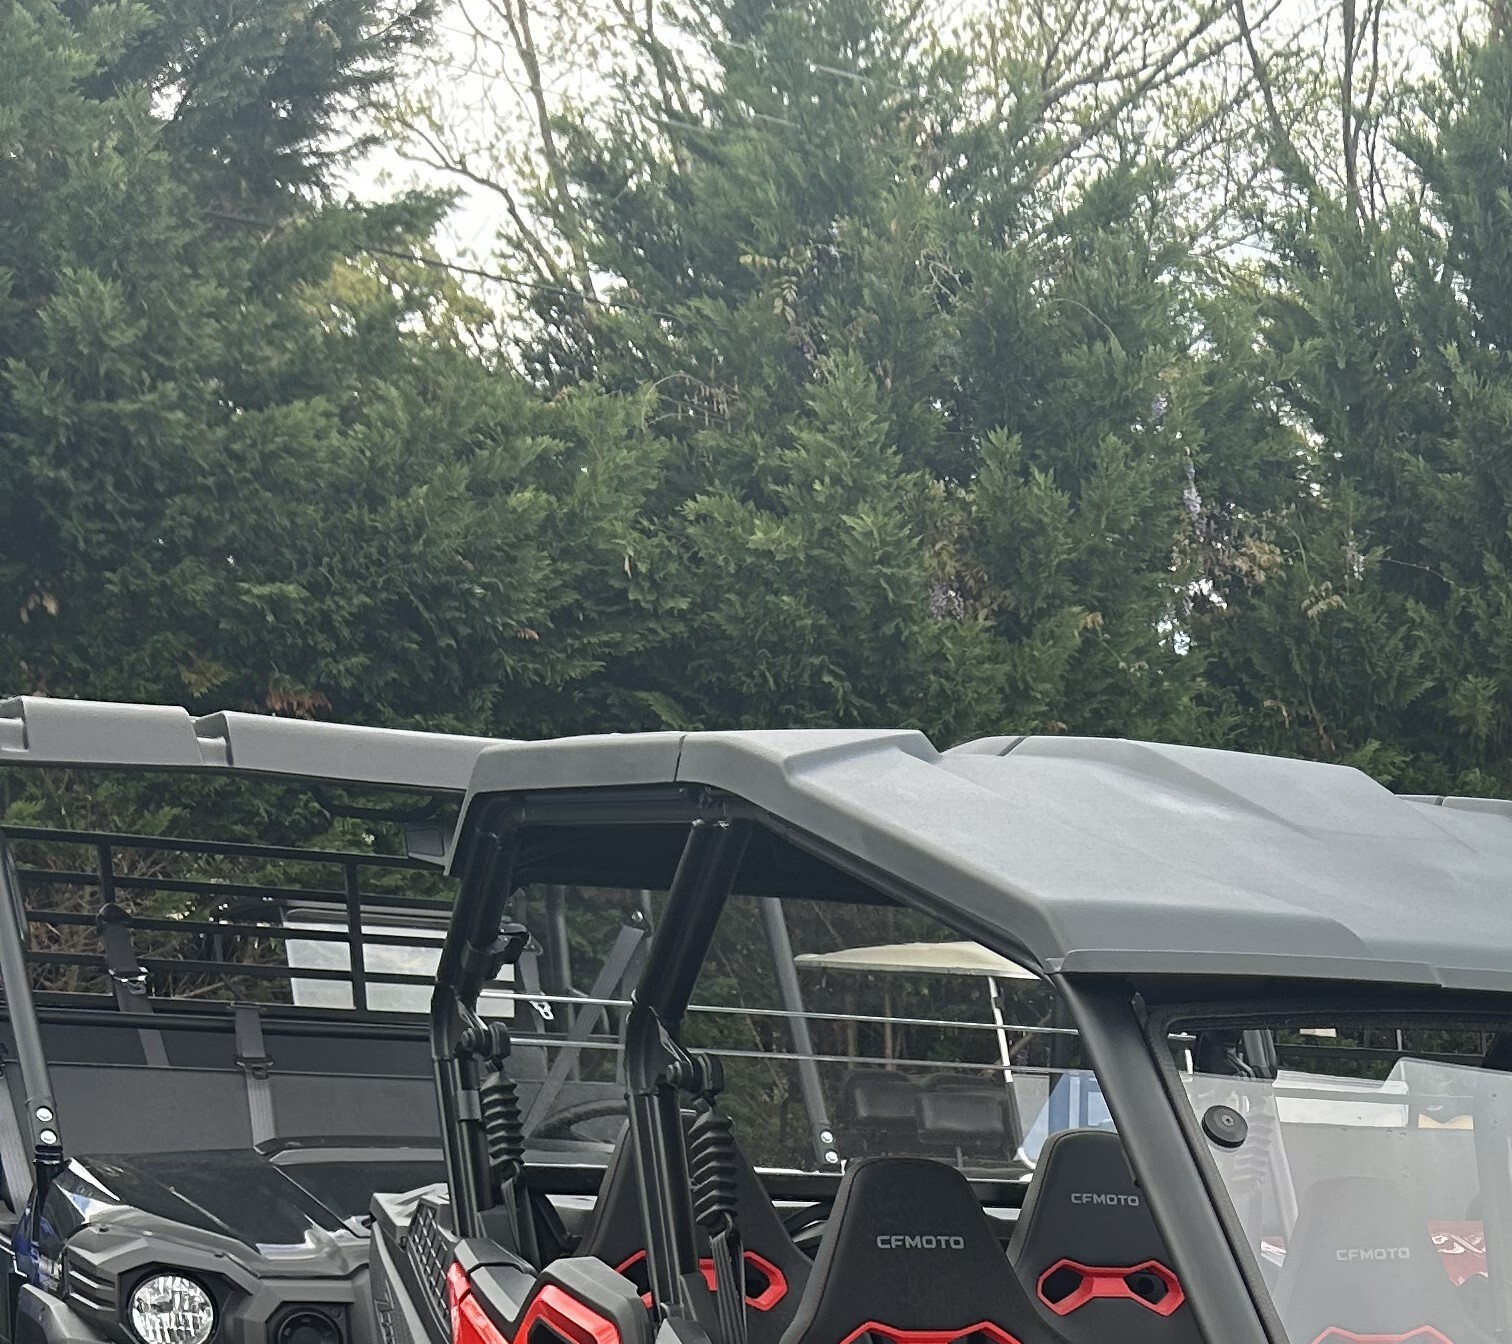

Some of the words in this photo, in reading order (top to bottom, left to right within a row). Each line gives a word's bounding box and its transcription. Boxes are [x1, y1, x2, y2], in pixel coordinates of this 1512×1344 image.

[1070, 1193, 1140, 1207] CFMOTO
[876, 1235, 965, 1249] CFMOTO
[1336, 1247, 1410, 1260] CFMOTO
